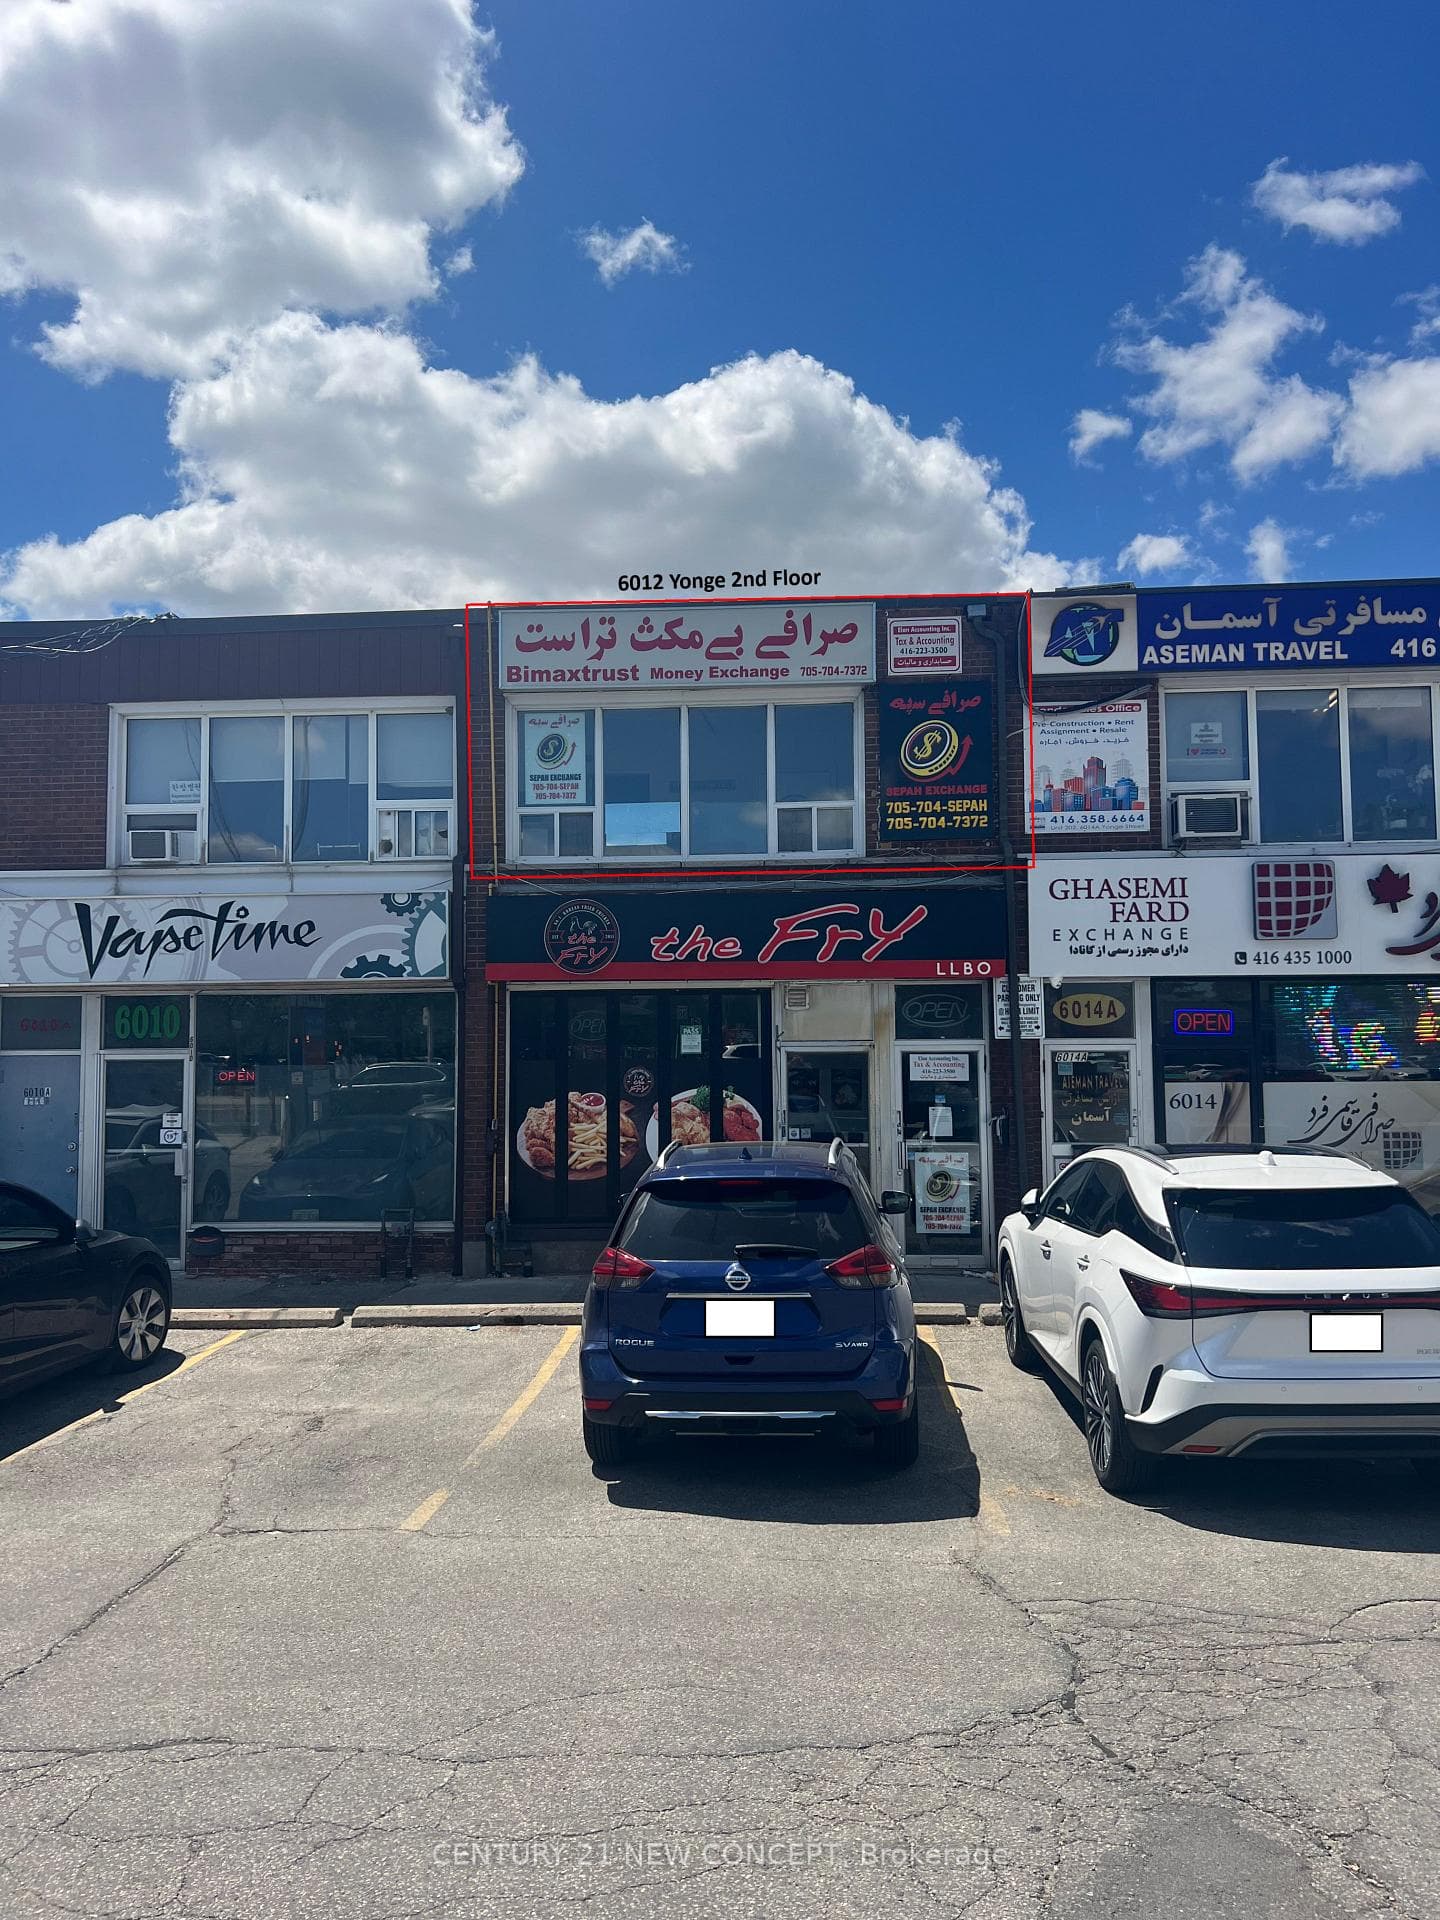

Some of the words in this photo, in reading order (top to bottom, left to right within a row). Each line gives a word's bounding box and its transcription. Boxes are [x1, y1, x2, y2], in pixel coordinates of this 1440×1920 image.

[917, 636, 955, 646] Accounting
[900, 647, 948, 655] 416-223-3500
[1142, 643, 1244, 664] ASEMAN
[1253, 640, 1348, 661] TRAVEL
[1390, 637, 1436, 658] 416
[506, 664, 640, 683] Bimaxtrust
[650, 667, 704, 682] Money
[709, 665, 790, 680] Exchange
[800, 665, 867, 677] 705-704-7372
[1040, 728, 1089, 736] Assignment
[886, 786, 923, 797] SEPAH
[925, 784, 988, 796] EXCHANGE
[886, 800, 988, 814] 705-704-SEPAH
[886, 815, 988, 830] 705-704-7372
[1050, 814, 1145, 824] 416.358.6664
[1049, 877, 1189, 900] GHASEMI
[1110, 901, 1189, 922] FARD
[1053, 927, 1188, 941] EXCHANGE
[650, 924, 742, 962] the
[1253, 951, 1279, 965] 416
[1284, 951, 1311, 965] 435
[1317, 951, 1352, 965] 1000
[937, 962, 991, 976] LLBO
[1025, 993, 1040, 1002] ONLY
[904, 1000, 968, 1019] OPEN
[1022, 1006, 1039, 1015] LIMIT
[1059, 1000, 1118, 1019] 6014A
[114, 1004, 181, 1040] 6010
[1177, 1013, 1231, 1031] OPEN
[1056, 1051, 1089, 1061] 6014A
[218, 1071, 256, 1081] OPEN
[24, 1087, 51, 1097] 6010A
[1169, 1093, 1217, 1109] 6014
[615, 1339, 654, 1347] ROGUE
